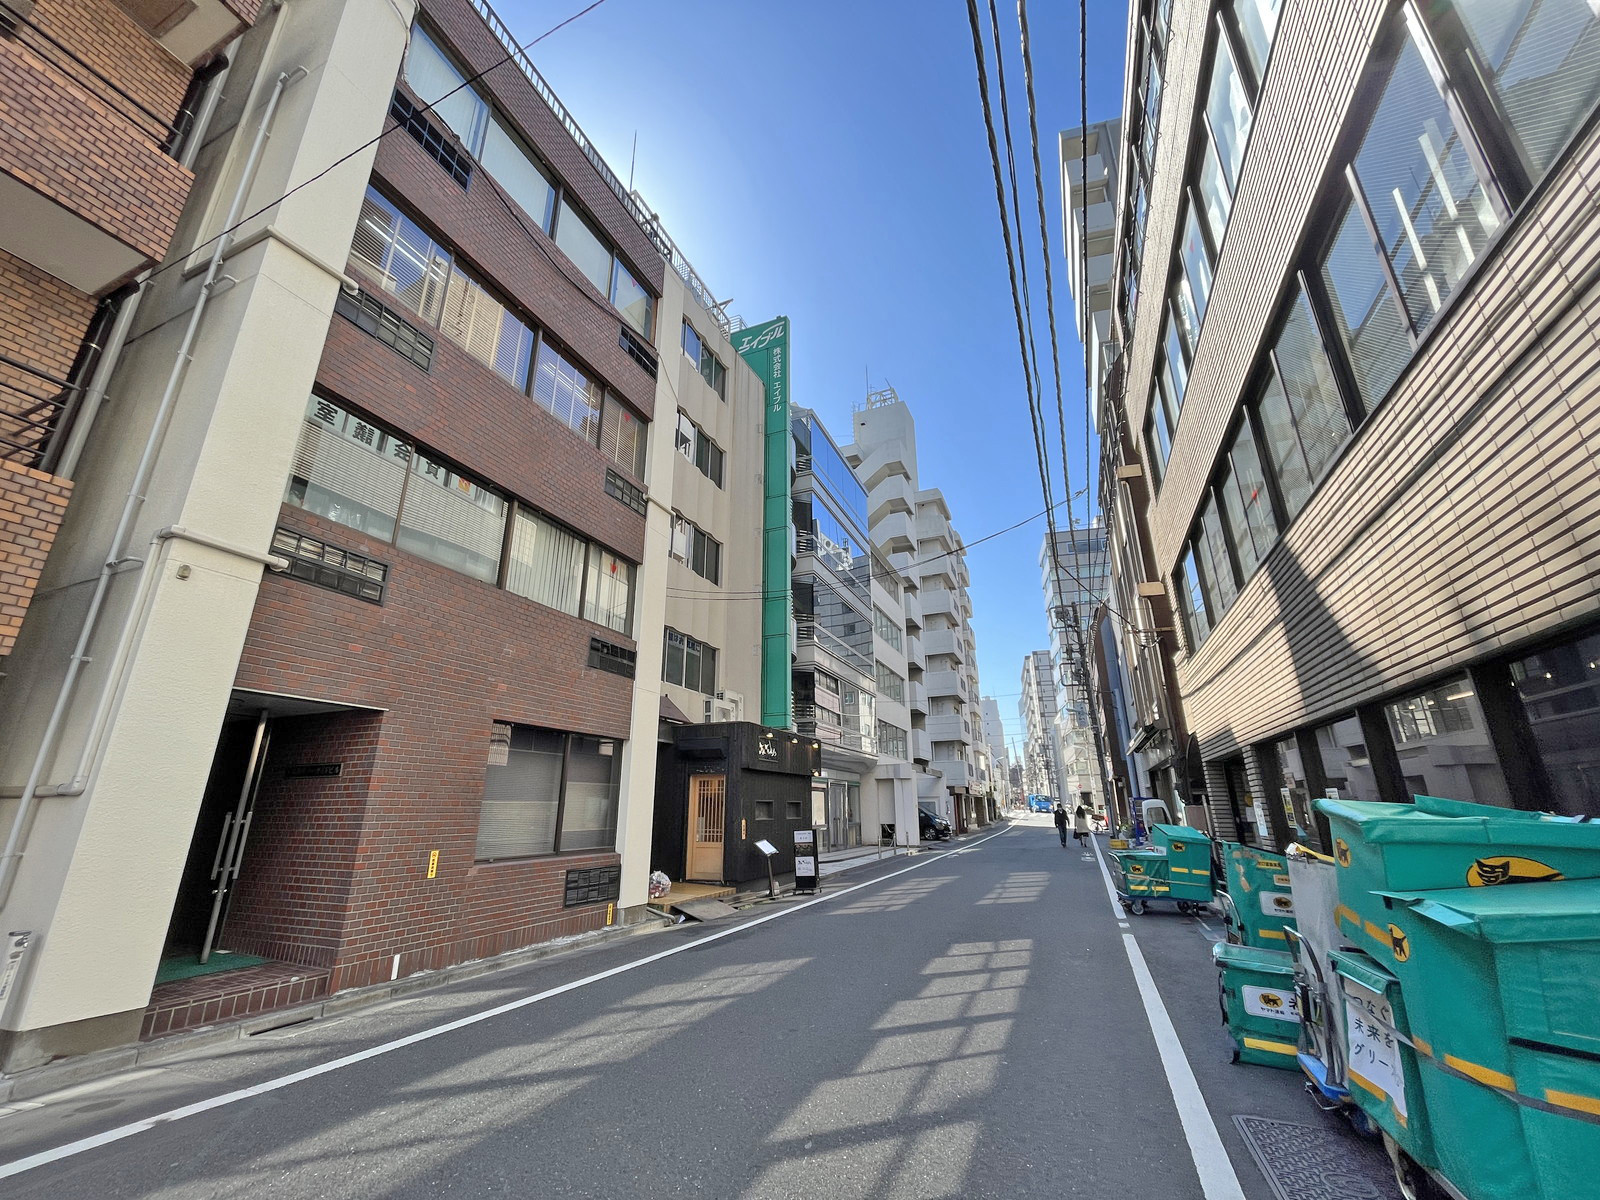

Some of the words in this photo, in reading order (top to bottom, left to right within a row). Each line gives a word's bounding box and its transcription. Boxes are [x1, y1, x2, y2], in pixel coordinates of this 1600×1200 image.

[738, 321, 785, 354] エイブル
[773, 347, 782, 378] 株式会社
[1354, 1017, 1394, 1049] 未来を
